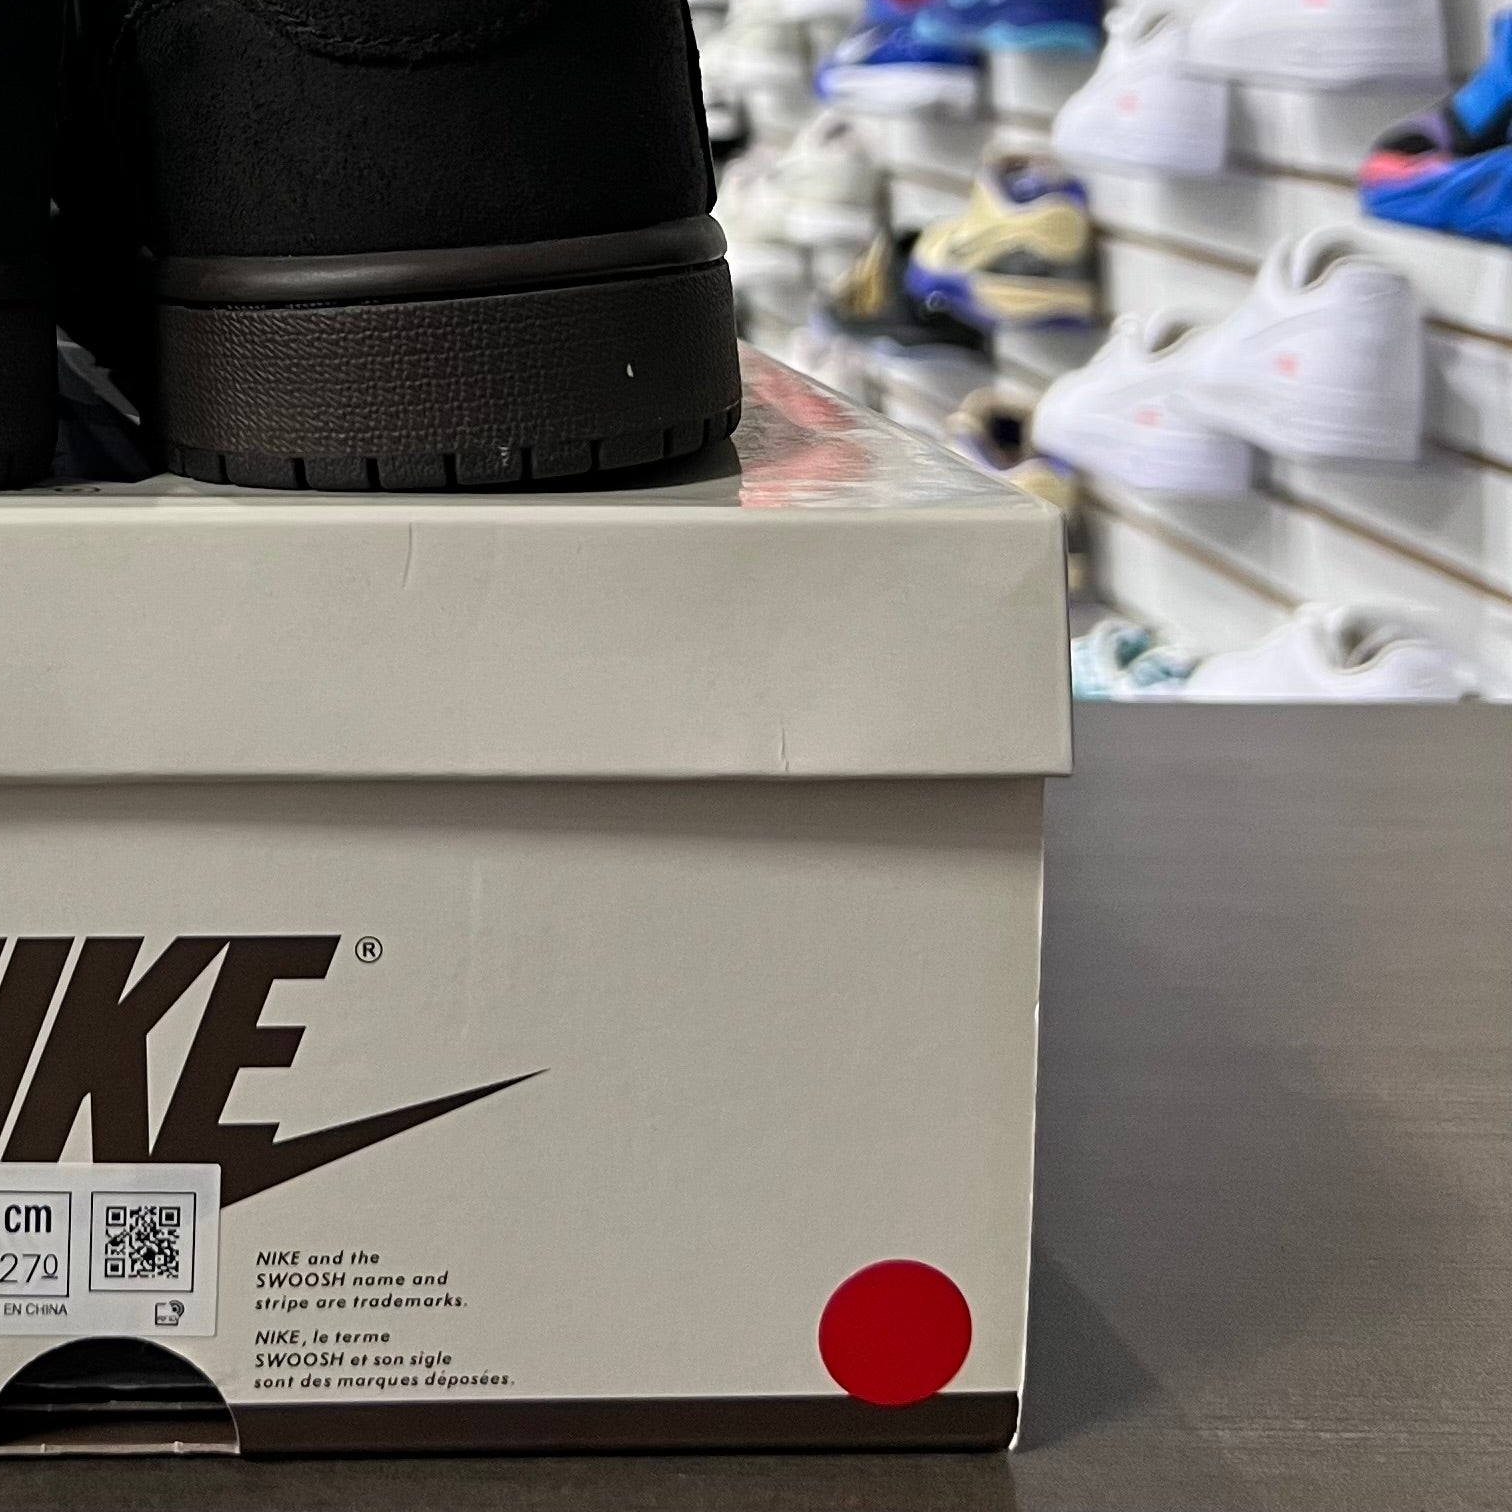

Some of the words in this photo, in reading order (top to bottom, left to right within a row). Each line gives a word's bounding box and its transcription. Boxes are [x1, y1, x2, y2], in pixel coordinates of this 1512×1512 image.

[5, 1205, 51, 1233] cm
[256, 1251, 300, 1266] NIKE
[308, 1250, 343, 1265] and
[351, 1250, 379, 1264] the
[257, 1272, 345, 1288] SWOOSH
[353, 1276, 405, 1286] name
[413, 1270, 448, 1285] and
[4, 1303, 22, 1316] EN
[26, 1303, 67, 1316] CHINA
[255, 1295, 308, 1313] stripe
[316, 1299, 346, 1309] are
[354, 1293, 467, 1308] trademarks.
[255, 1330, 306, 1347] NIKE,
[313, 1330, 328, 1344] le
[336, 1332, 390, 1343] terme
[255, 1352, 344, 1368] SWOOSH
[351, 1355, 367, 1366] et
[374, 1356, 403, 1366] son
[410, 1351, 451, 1368] sigle
[254, 1376, 293, 1389] sont
[301, 1373, 331, 1388] des
[338, 1376, 418, 1390] marques
[425, 1370, 514, 1389] déposées.
